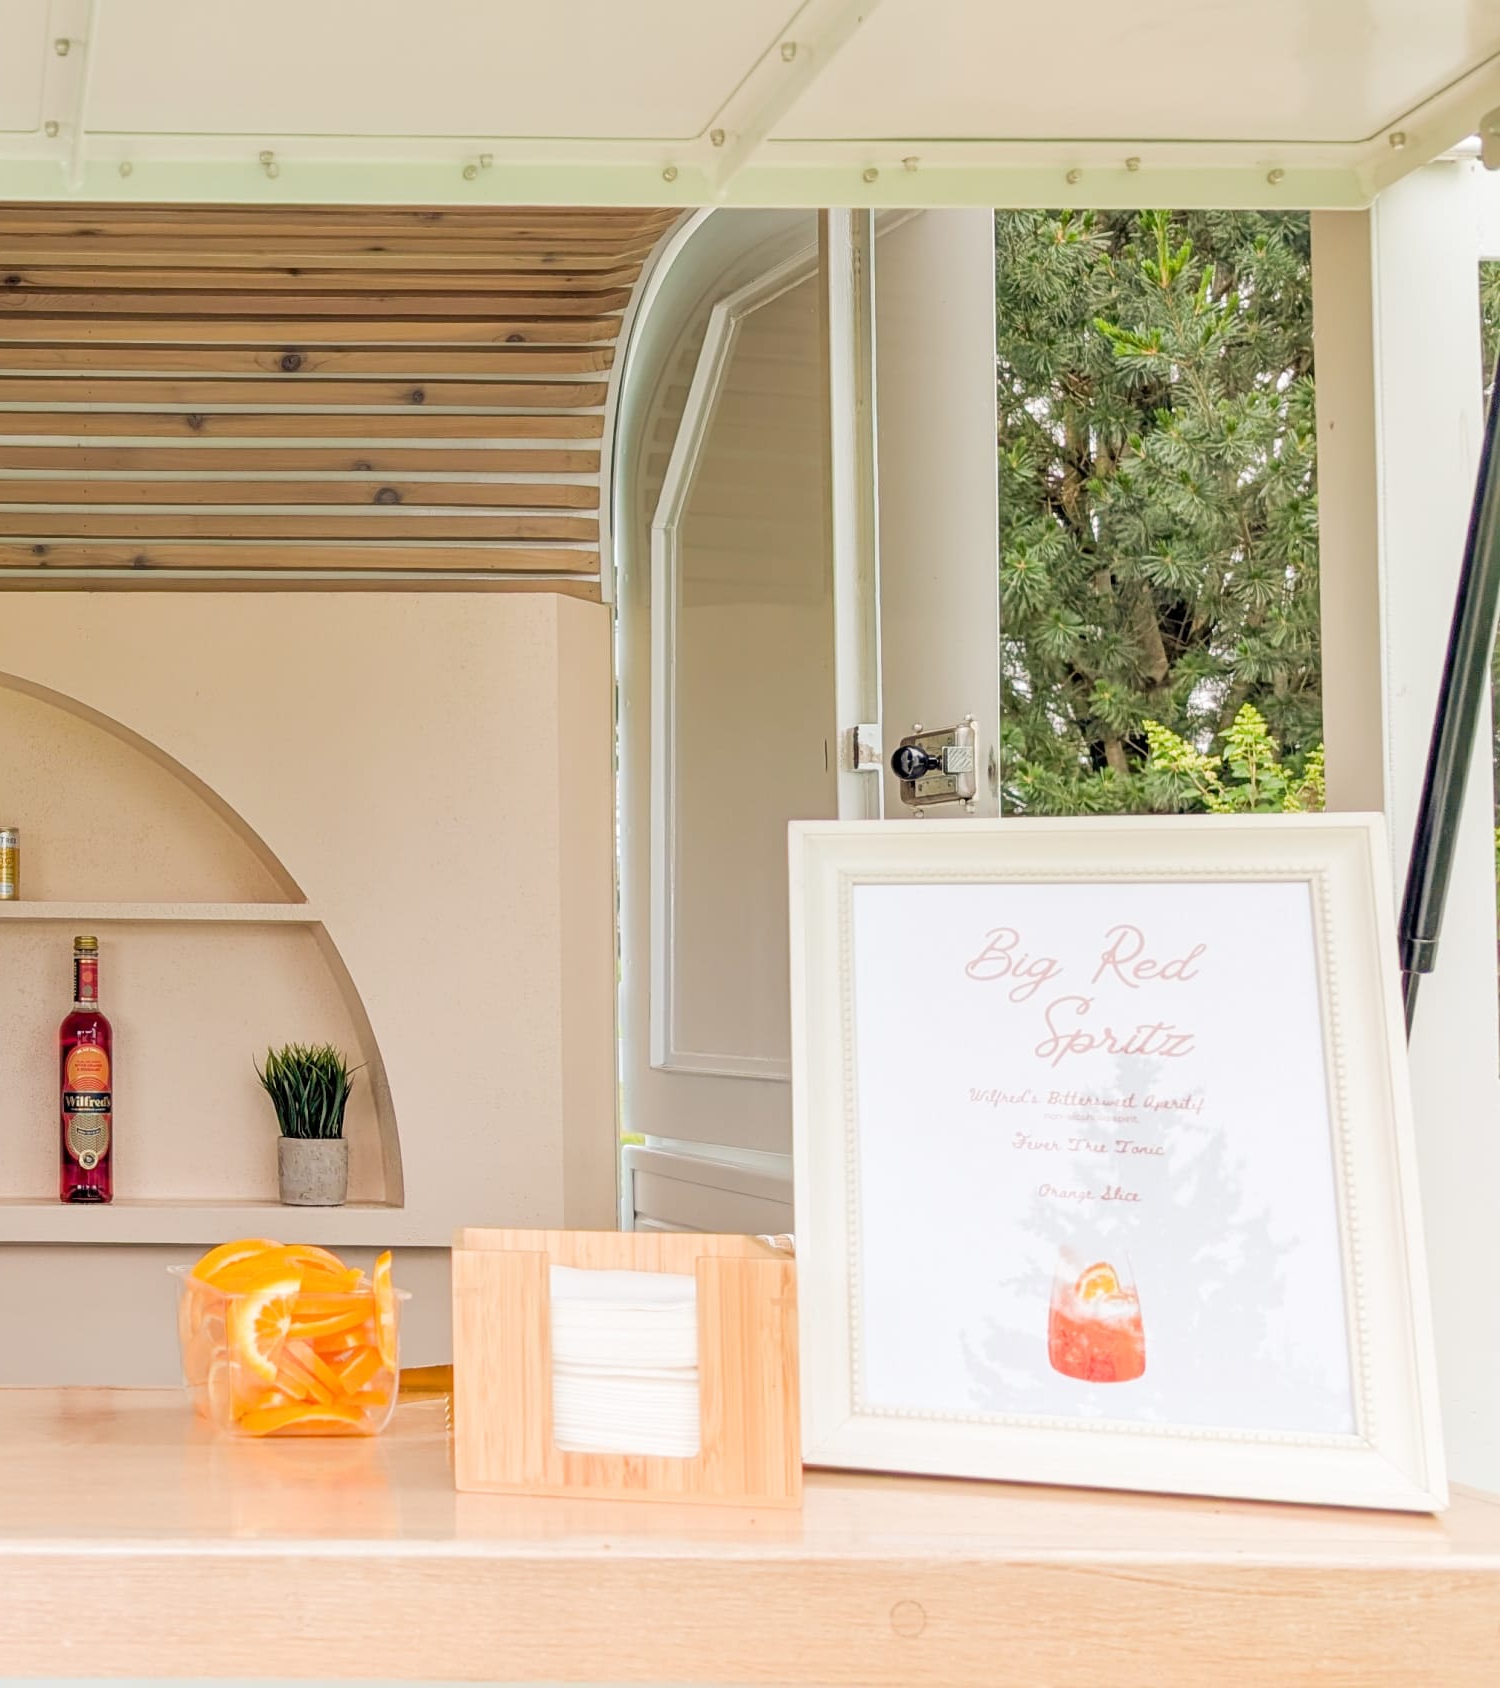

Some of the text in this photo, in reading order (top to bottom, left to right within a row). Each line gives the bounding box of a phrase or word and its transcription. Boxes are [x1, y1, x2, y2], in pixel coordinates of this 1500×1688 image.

[965, 924, 1207, 1003] Big Red
[1035, 995, 1196, 1068] Spritz
[1012, 1132, 1165, 1156] Fever Tree Tonic
[1038, 1183, 1141, 1203] Orange Slice
